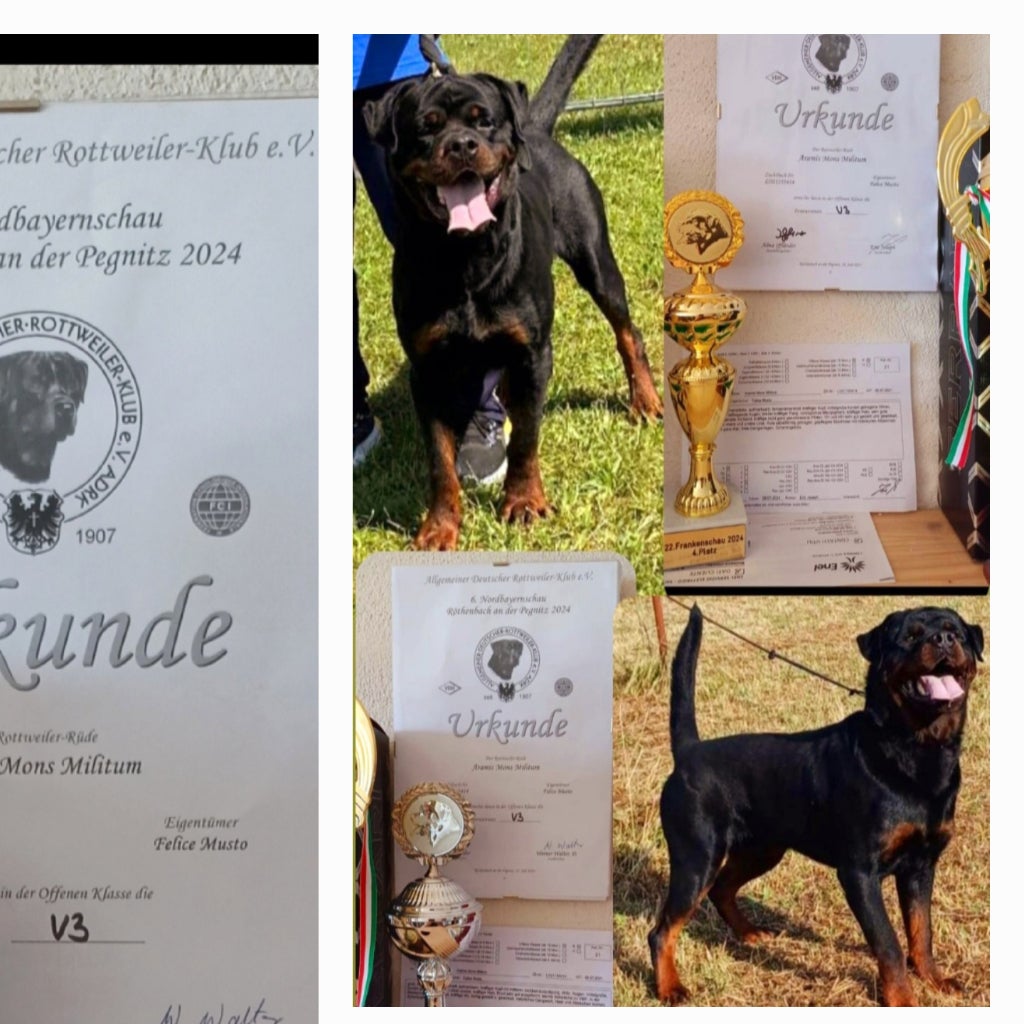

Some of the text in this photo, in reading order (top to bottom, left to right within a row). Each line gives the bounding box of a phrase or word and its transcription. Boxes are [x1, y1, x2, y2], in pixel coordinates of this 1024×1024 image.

[774, 100, 894, 136] Urkunde
[53, 131, 259, 167] Rottweiler-Klub
[267, 130, 315, 158] e.V.
[30, 243, 71, 269] der
[76, 242, 171, 275] Pegnitz
[180, 242, 242, 266] 2024
[75, 465, 116, 509] ADRK
[76, 528, 116, 545] 1907
[728, 534, 744, 544] 2024
[551, 605, 571, 614] 2024
[448, 708, 568, 744] Urkunde
[59, 754, 143, 775] Militum
[164, 816, 239, 832] Eigentümer
[154, 835, 248, 851] Felice Musto
[0, 888, 12, 899] in
[16, 887, 36, 899] der
[38, 887, 88, 903] Offenen
[91, 886, 133, 901] Klasse
[135, 886, 154, 900] die
[51, 912, 89, 943] V3
